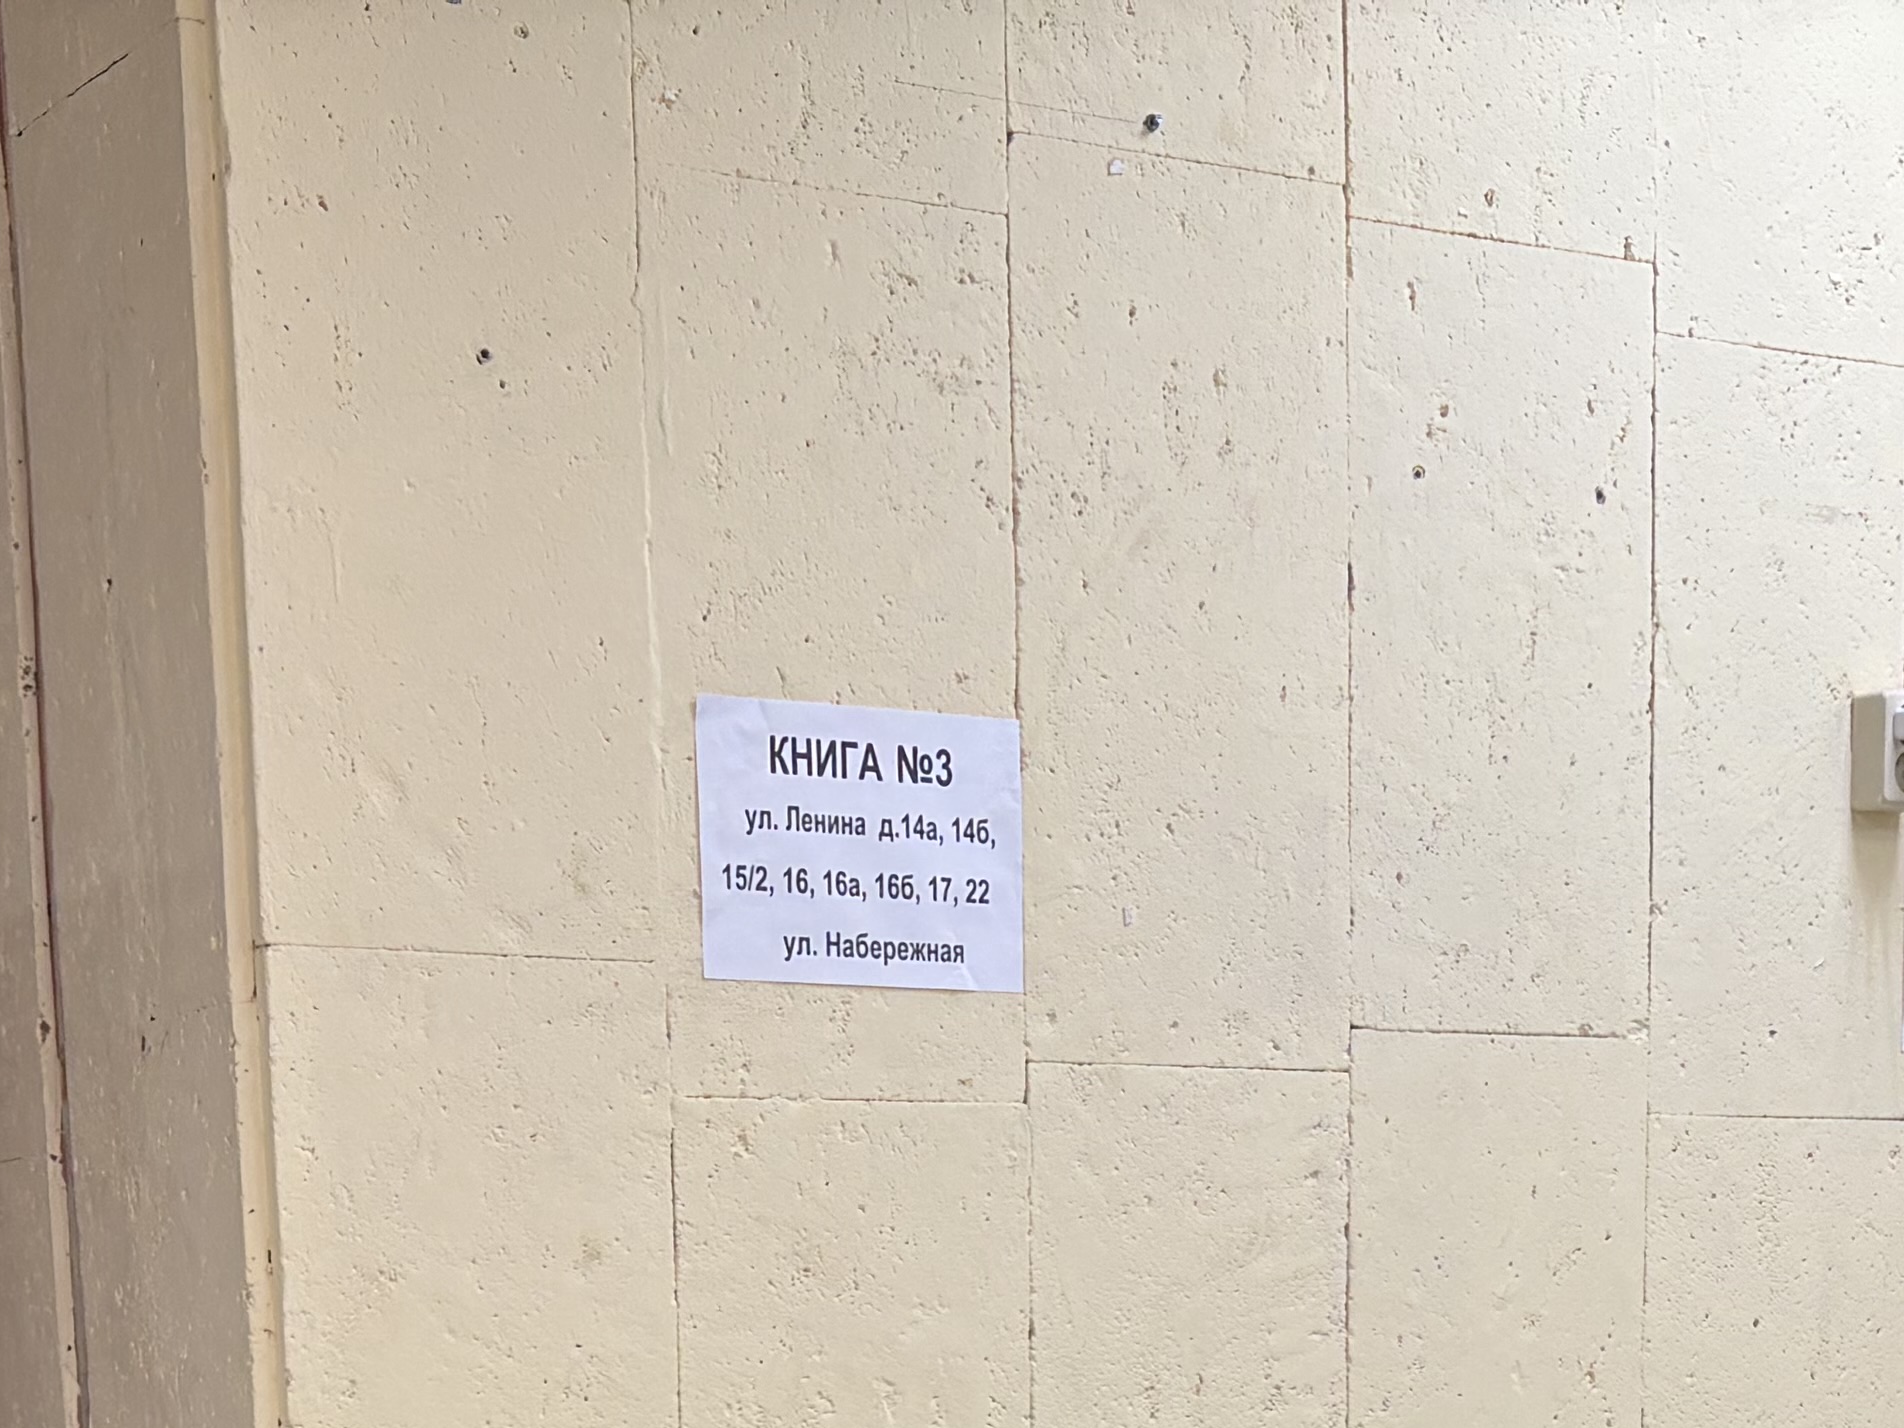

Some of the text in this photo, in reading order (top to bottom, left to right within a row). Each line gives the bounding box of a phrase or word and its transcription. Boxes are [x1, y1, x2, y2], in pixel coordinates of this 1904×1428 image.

[769, 734, 953, 787] КНИГА №3
[744, 805, 996, 850] ул. Ленина д.14а, 14б,
[722, 863, 990, 907] 15/2, 16, 16а, 16б, 17, 22
[783, 931, 965, 966] ул. Набережная
